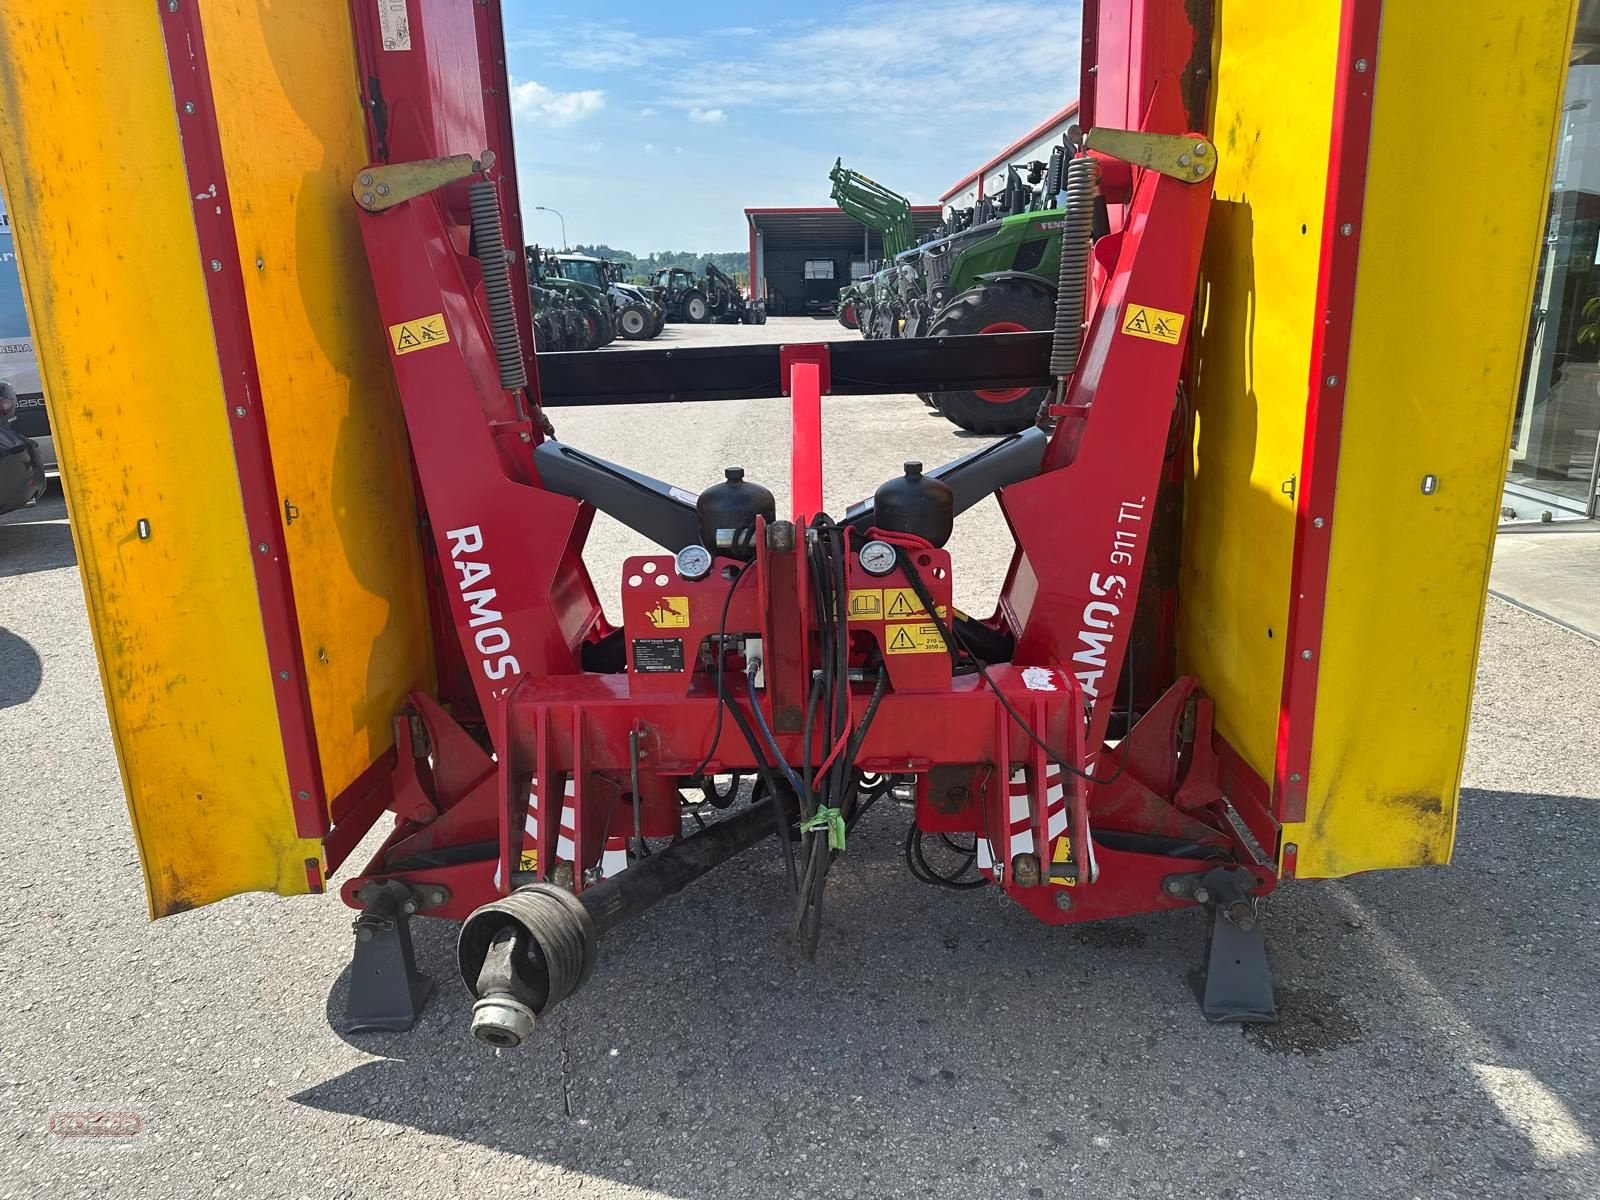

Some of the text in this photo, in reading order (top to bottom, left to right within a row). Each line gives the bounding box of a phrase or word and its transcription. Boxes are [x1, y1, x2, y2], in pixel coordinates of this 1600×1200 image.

[1041, 221, 1065, 230] FEND
[0, 344, 33, 354] ALTRA
[445, 525, 521, 681] RAMOS
[1071, 572, 1127, 707] AMOS
[1110, 530, 1138, 566] 911
